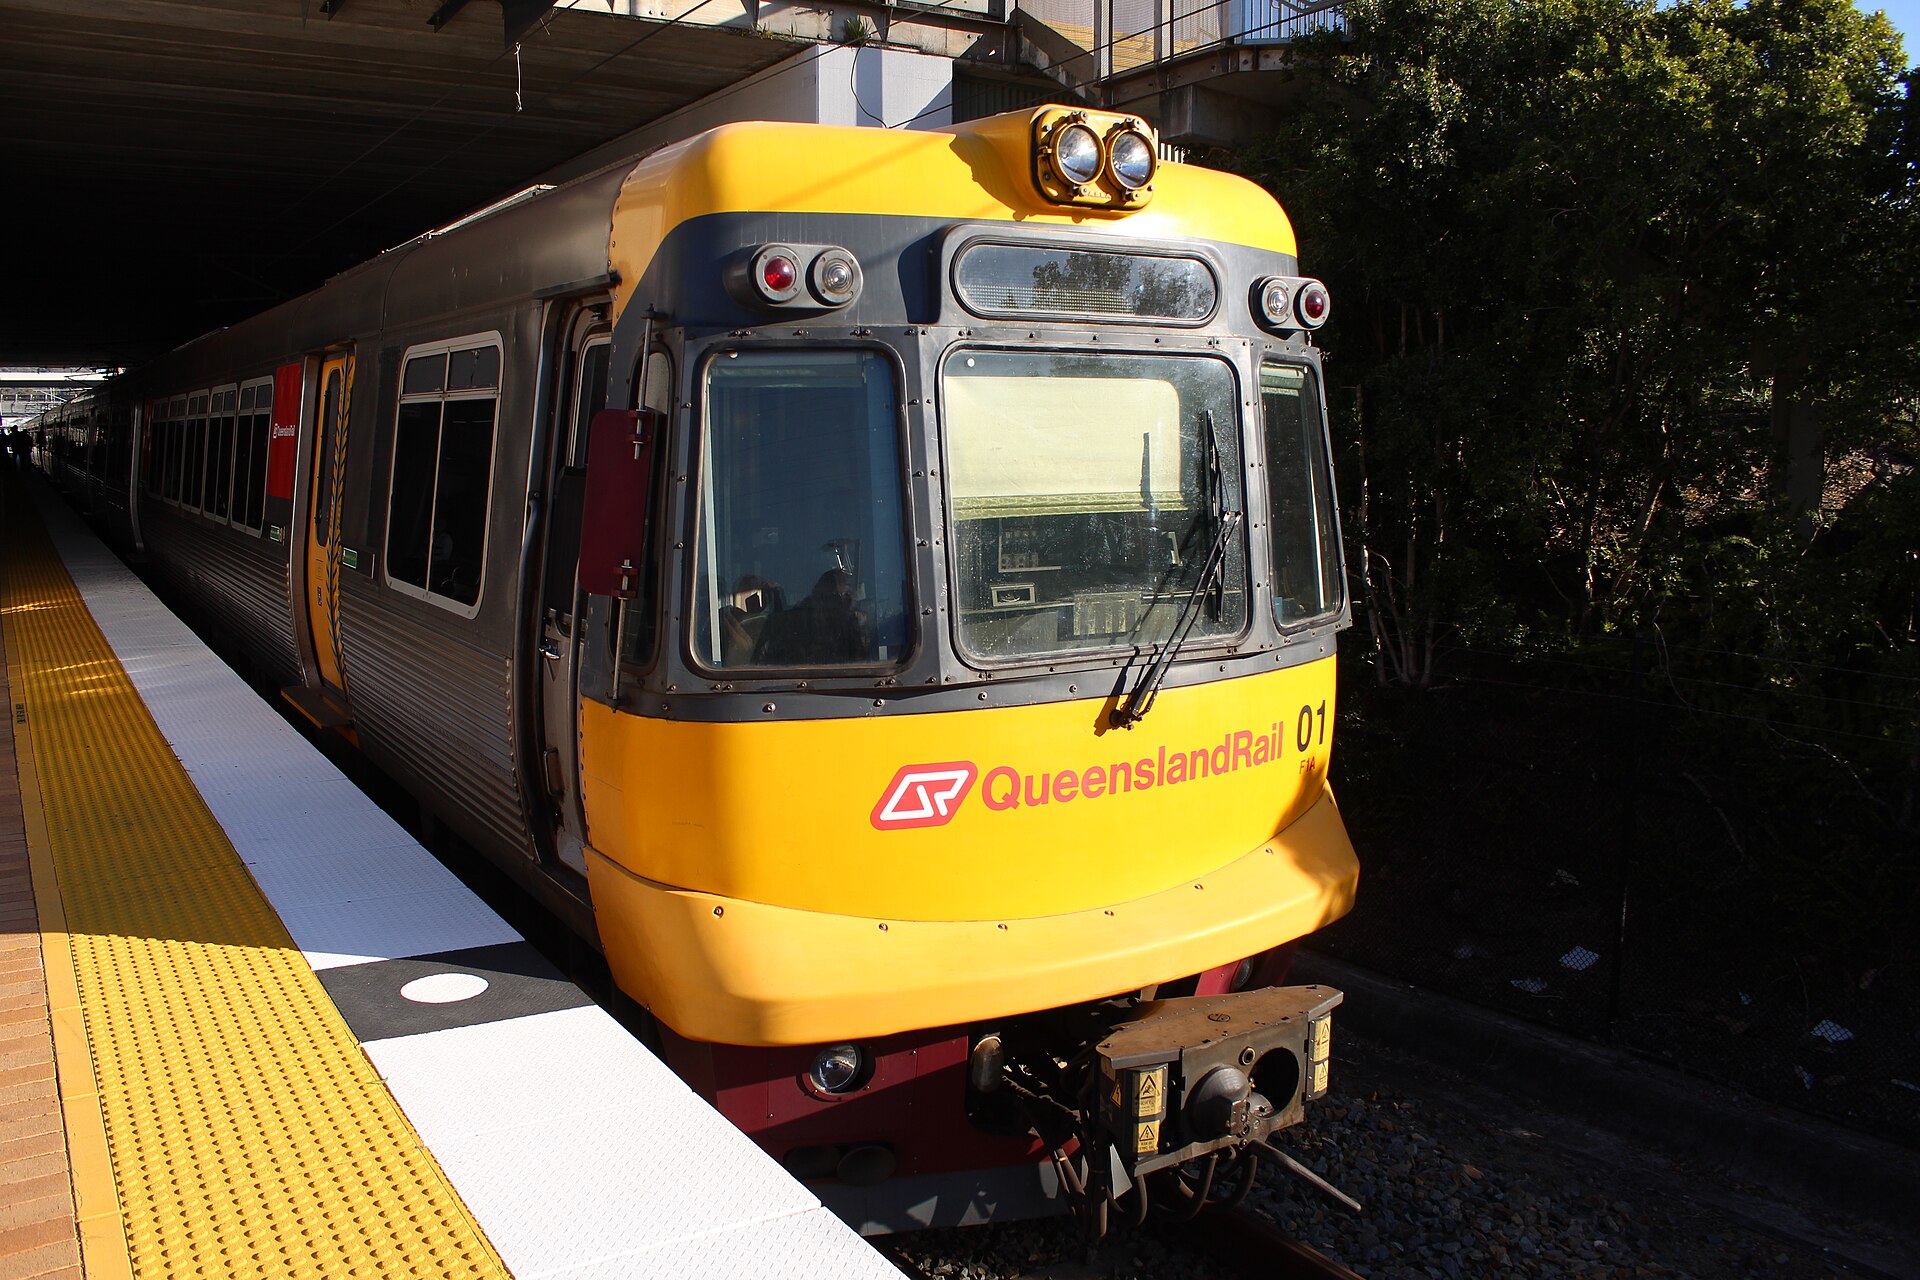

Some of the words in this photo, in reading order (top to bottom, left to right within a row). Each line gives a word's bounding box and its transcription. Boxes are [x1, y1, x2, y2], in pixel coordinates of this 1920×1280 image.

[1297, 699, 1326, 752] 01
[981, 722, 1284, 811] QueenslandRail
[1299, 756, 1316, 775] F1A
